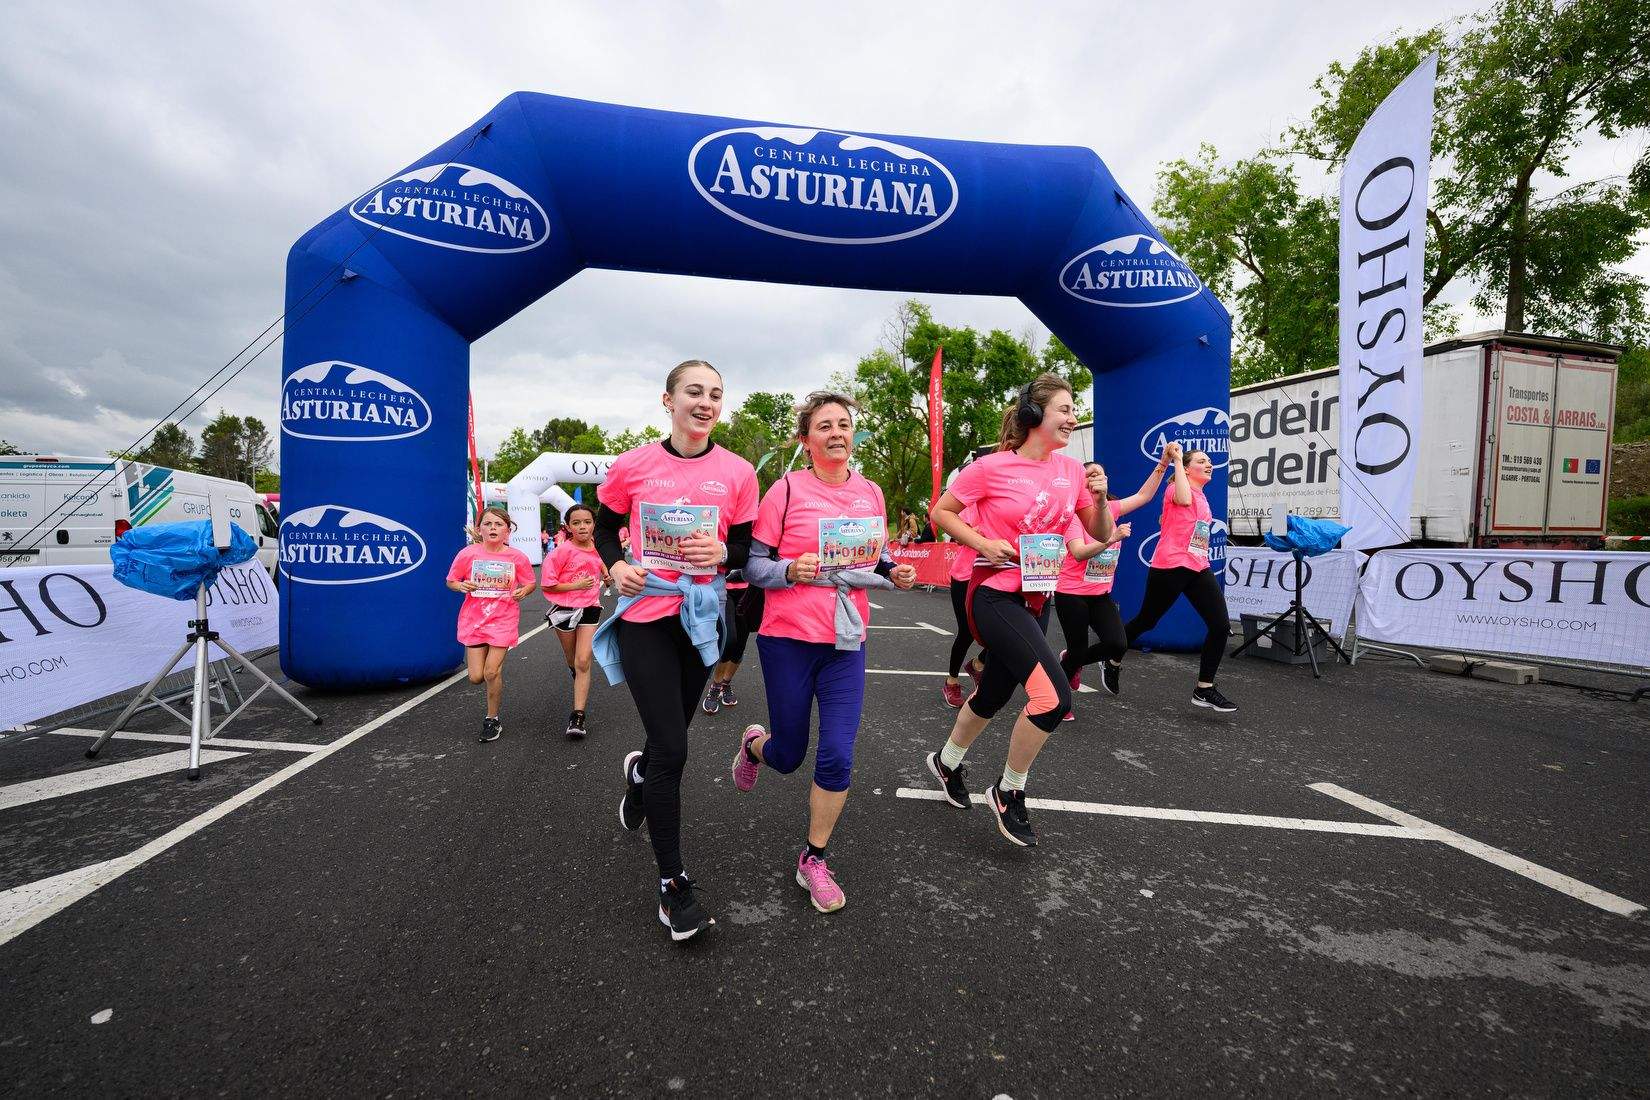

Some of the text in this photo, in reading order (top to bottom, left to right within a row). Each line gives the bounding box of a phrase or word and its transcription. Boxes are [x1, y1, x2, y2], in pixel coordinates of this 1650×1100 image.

[754, 146, 931, 177] CENTRAL LECHERA
[709, 144, 938, 217] ASTURIANA
[394, 186, 530, 214] CENTRAL LECHERA
[359, 190, 536, 242] ASTURIANA
[1101, 258, 1150, 268] CENTRAL
[1071, 262, 1198, 290] ASTURIANA
[1355, 156, 1415, 476] OYSHO
[294, 387, 413, 405] CENTRAL LECHERA
[1508, 386, 1549, 402] Transportes
[281, 391, 420, 428] ASTURIANA
[1507, 405, 1539, 423] COSTA
[1543, 409, 1552, 425] &
[289, 532, 407, 542] CENTRAL LECHERA
[902, 548, 930, 558] Santander
[1457, 614, 1597, 632] WWW.OYSHO.COM
